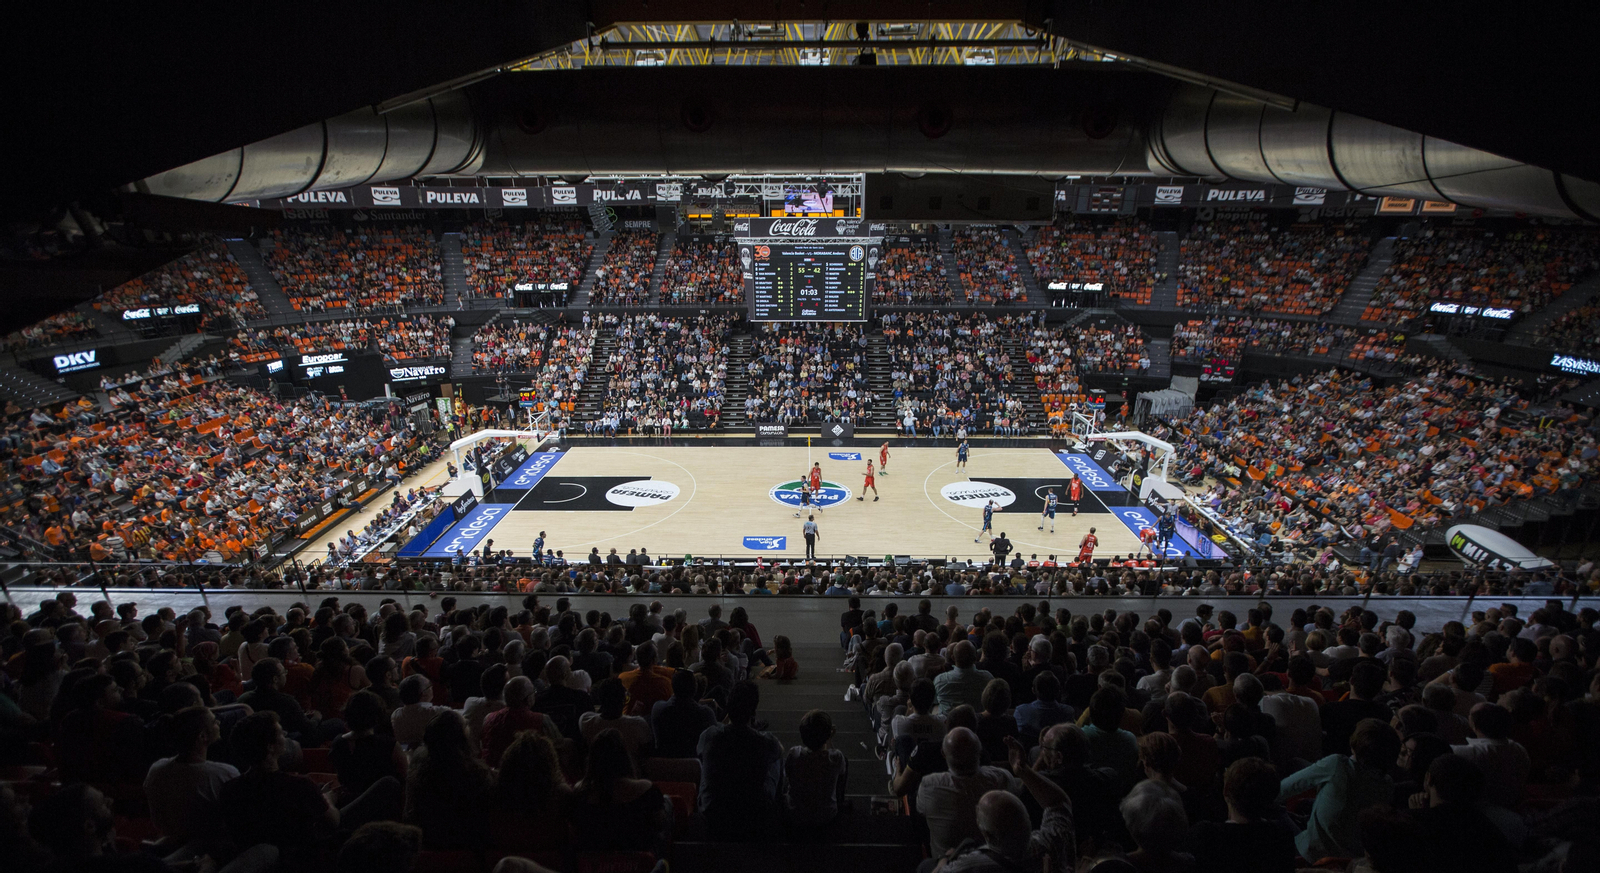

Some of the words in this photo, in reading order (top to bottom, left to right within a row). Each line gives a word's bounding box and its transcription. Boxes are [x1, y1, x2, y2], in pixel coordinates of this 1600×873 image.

[373, 189, 398, 197] PULEVA
[427, 191, 479, 203] PULEVA
[1207, 189, 1265, 201] PULEVA
[769, 218, 820, 236] Coca-Cola
[123, 308, 150, 320] Coca-Cola
[175, 304, 200, 315] Coca-Cola
[1430, 302, 1460, 314] Coca-Cola
[1482, 308, 1514, 319] Coca-Cola
[53, 350, 96, 369] DKV
[302, 353, 343, 363] Europcar
[404, 367, 446, 377] Navarro
[405, 392, 430, 404] Navarro
[514, 454, 556, 486] endesa
[1066, 456, 1110, 488] endesa
[611, 489, 671, 500] PAMESA
[949, 491, 1011, 501] PAMESA
[300, 514, 317, 528] PULEVA
[444, 508, 502, 553] endesa
